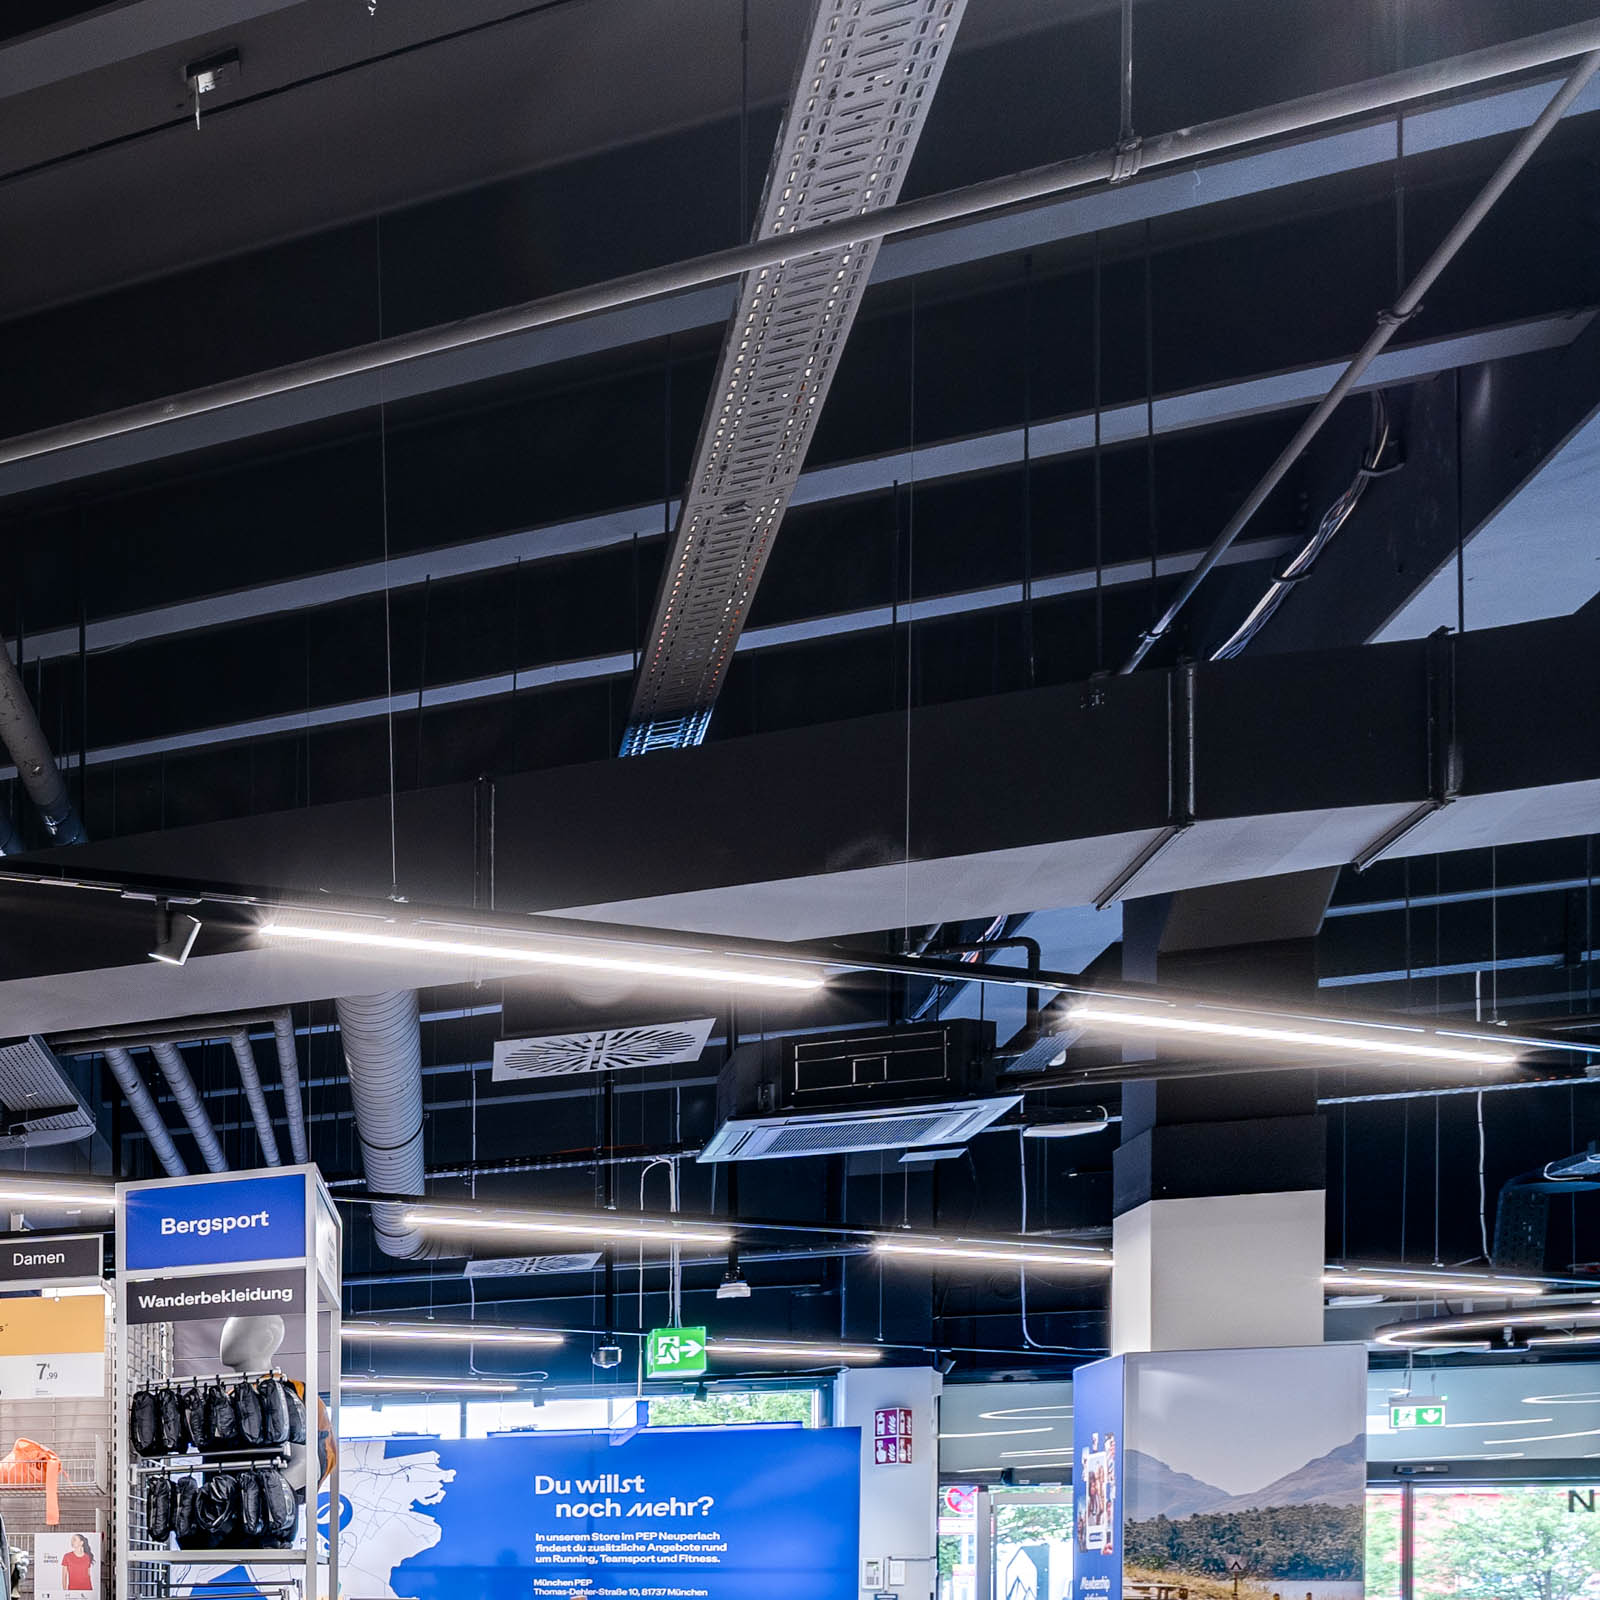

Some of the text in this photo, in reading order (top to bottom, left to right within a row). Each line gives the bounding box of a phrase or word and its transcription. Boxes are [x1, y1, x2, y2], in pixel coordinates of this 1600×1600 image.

[161, 1210, 269, 1236] Bergsport
[13, 1252, 65, 1266] Damen
[139, 1287, 293, 1309] Wanderbekleidung
[535, 1474, 645, 1494] Du willst
[556, 1498, 621, 1518] noch
[536, 1532, 720, 1543] In unserem Store im PEP Neuperlach
[536, 1543, 727, 1554] findest du zusätzliche Angebote rund
[552, 1554, 599, 1565] Running,
[600, 1554, 656, 1565] Teamsport
[656, 1554, 678, 1563] und
[679, 1554, 721, 1563] Fitness.
[533, 1579, 573, 1587] München
[533, 1588, 708, 1597] Thomas-Dehler-Straße 10, 81737 München
